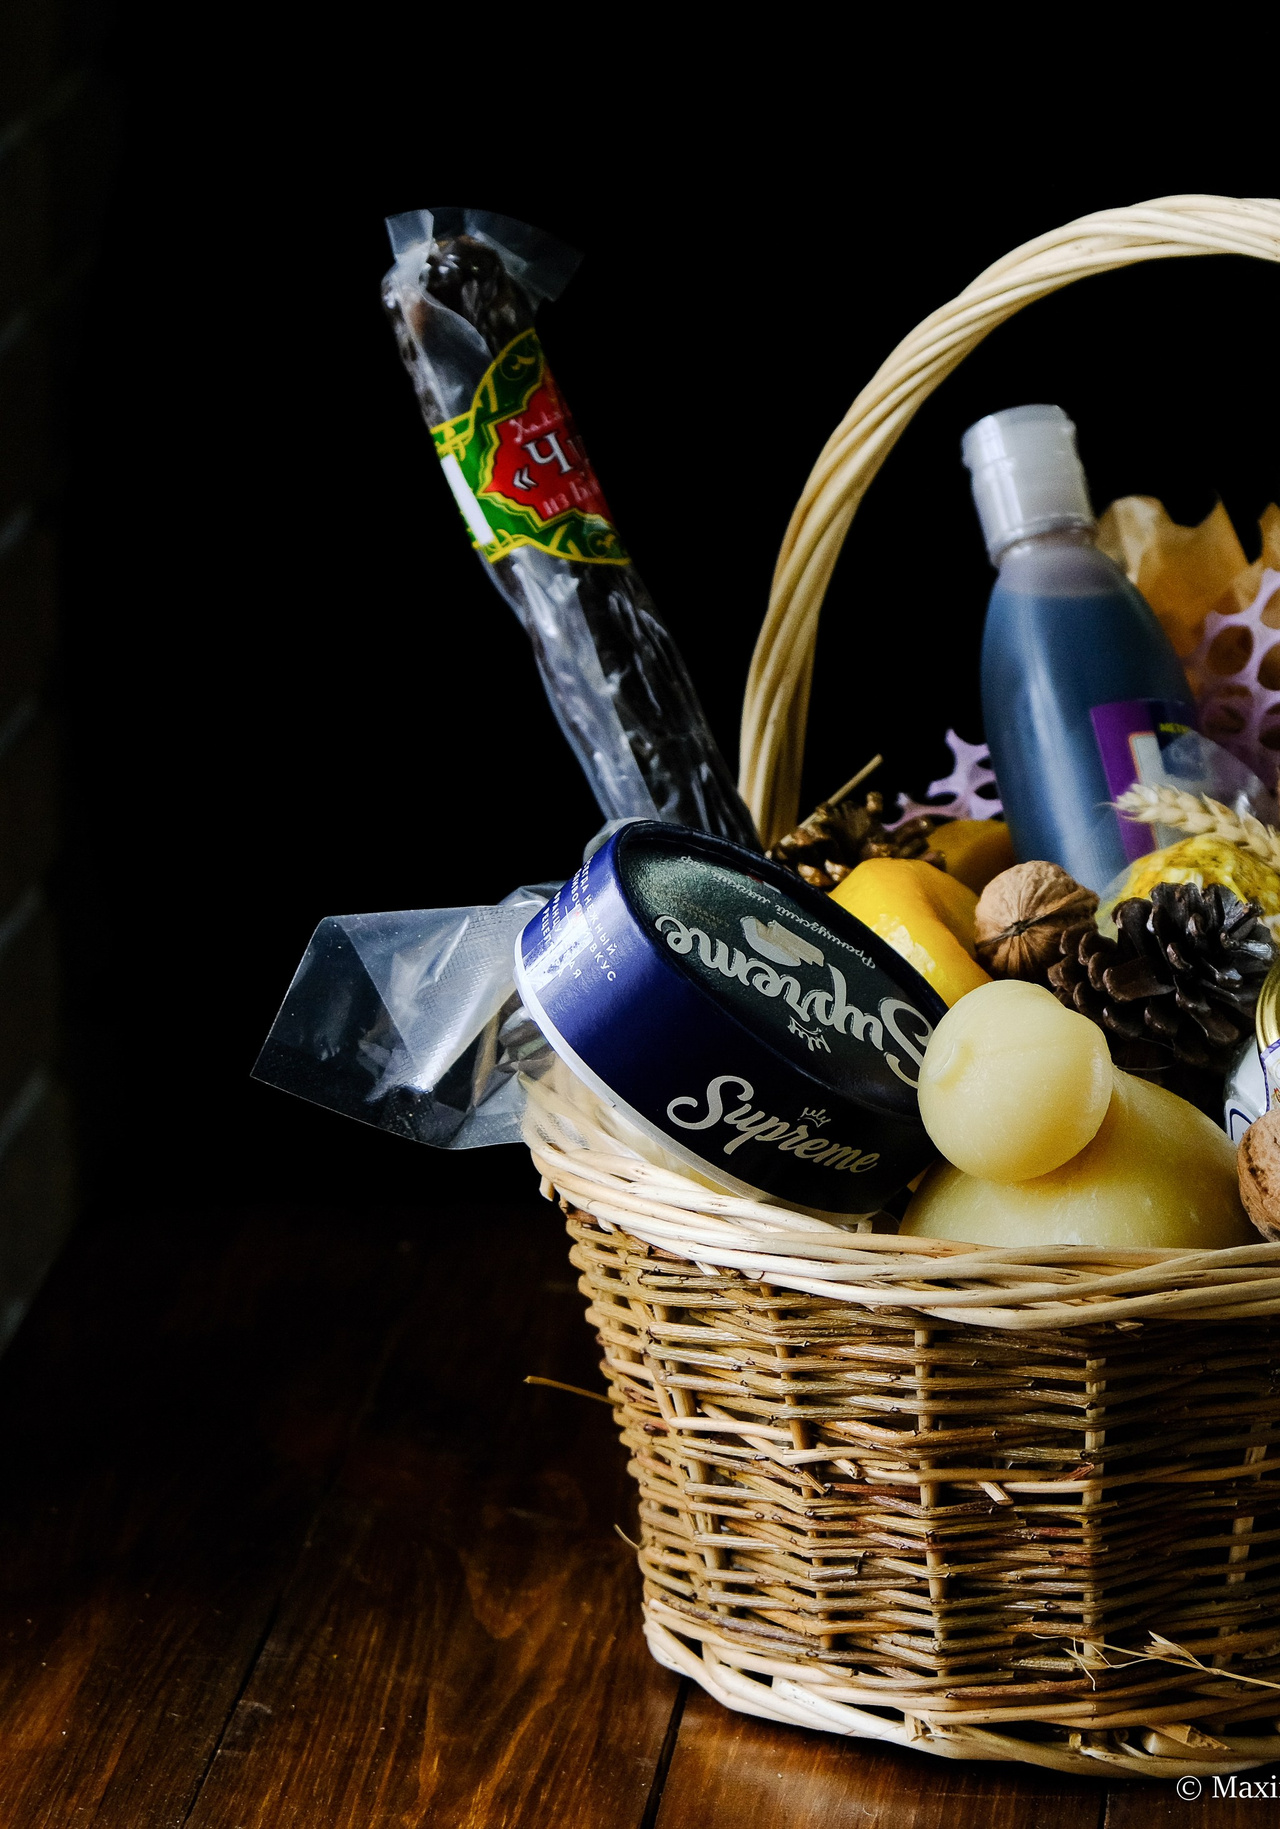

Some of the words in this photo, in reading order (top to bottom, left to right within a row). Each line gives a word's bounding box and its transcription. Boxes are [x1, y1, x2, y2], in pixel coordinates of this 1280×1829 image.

[680, 855, 708, 872] сыр
[711, 870, 771, 904] мягкий
[541, 906, 563, 978] РЕЦЕПТРА
[583, 894, 618, 956] НЕЖНЫЙ
[774, 904, 876, 969] Французский
[589, 942, 617, 982] ВКУС
[654, 914, 935, 1089] Supreme
[666, 1075, 881, 1175] Supreme
